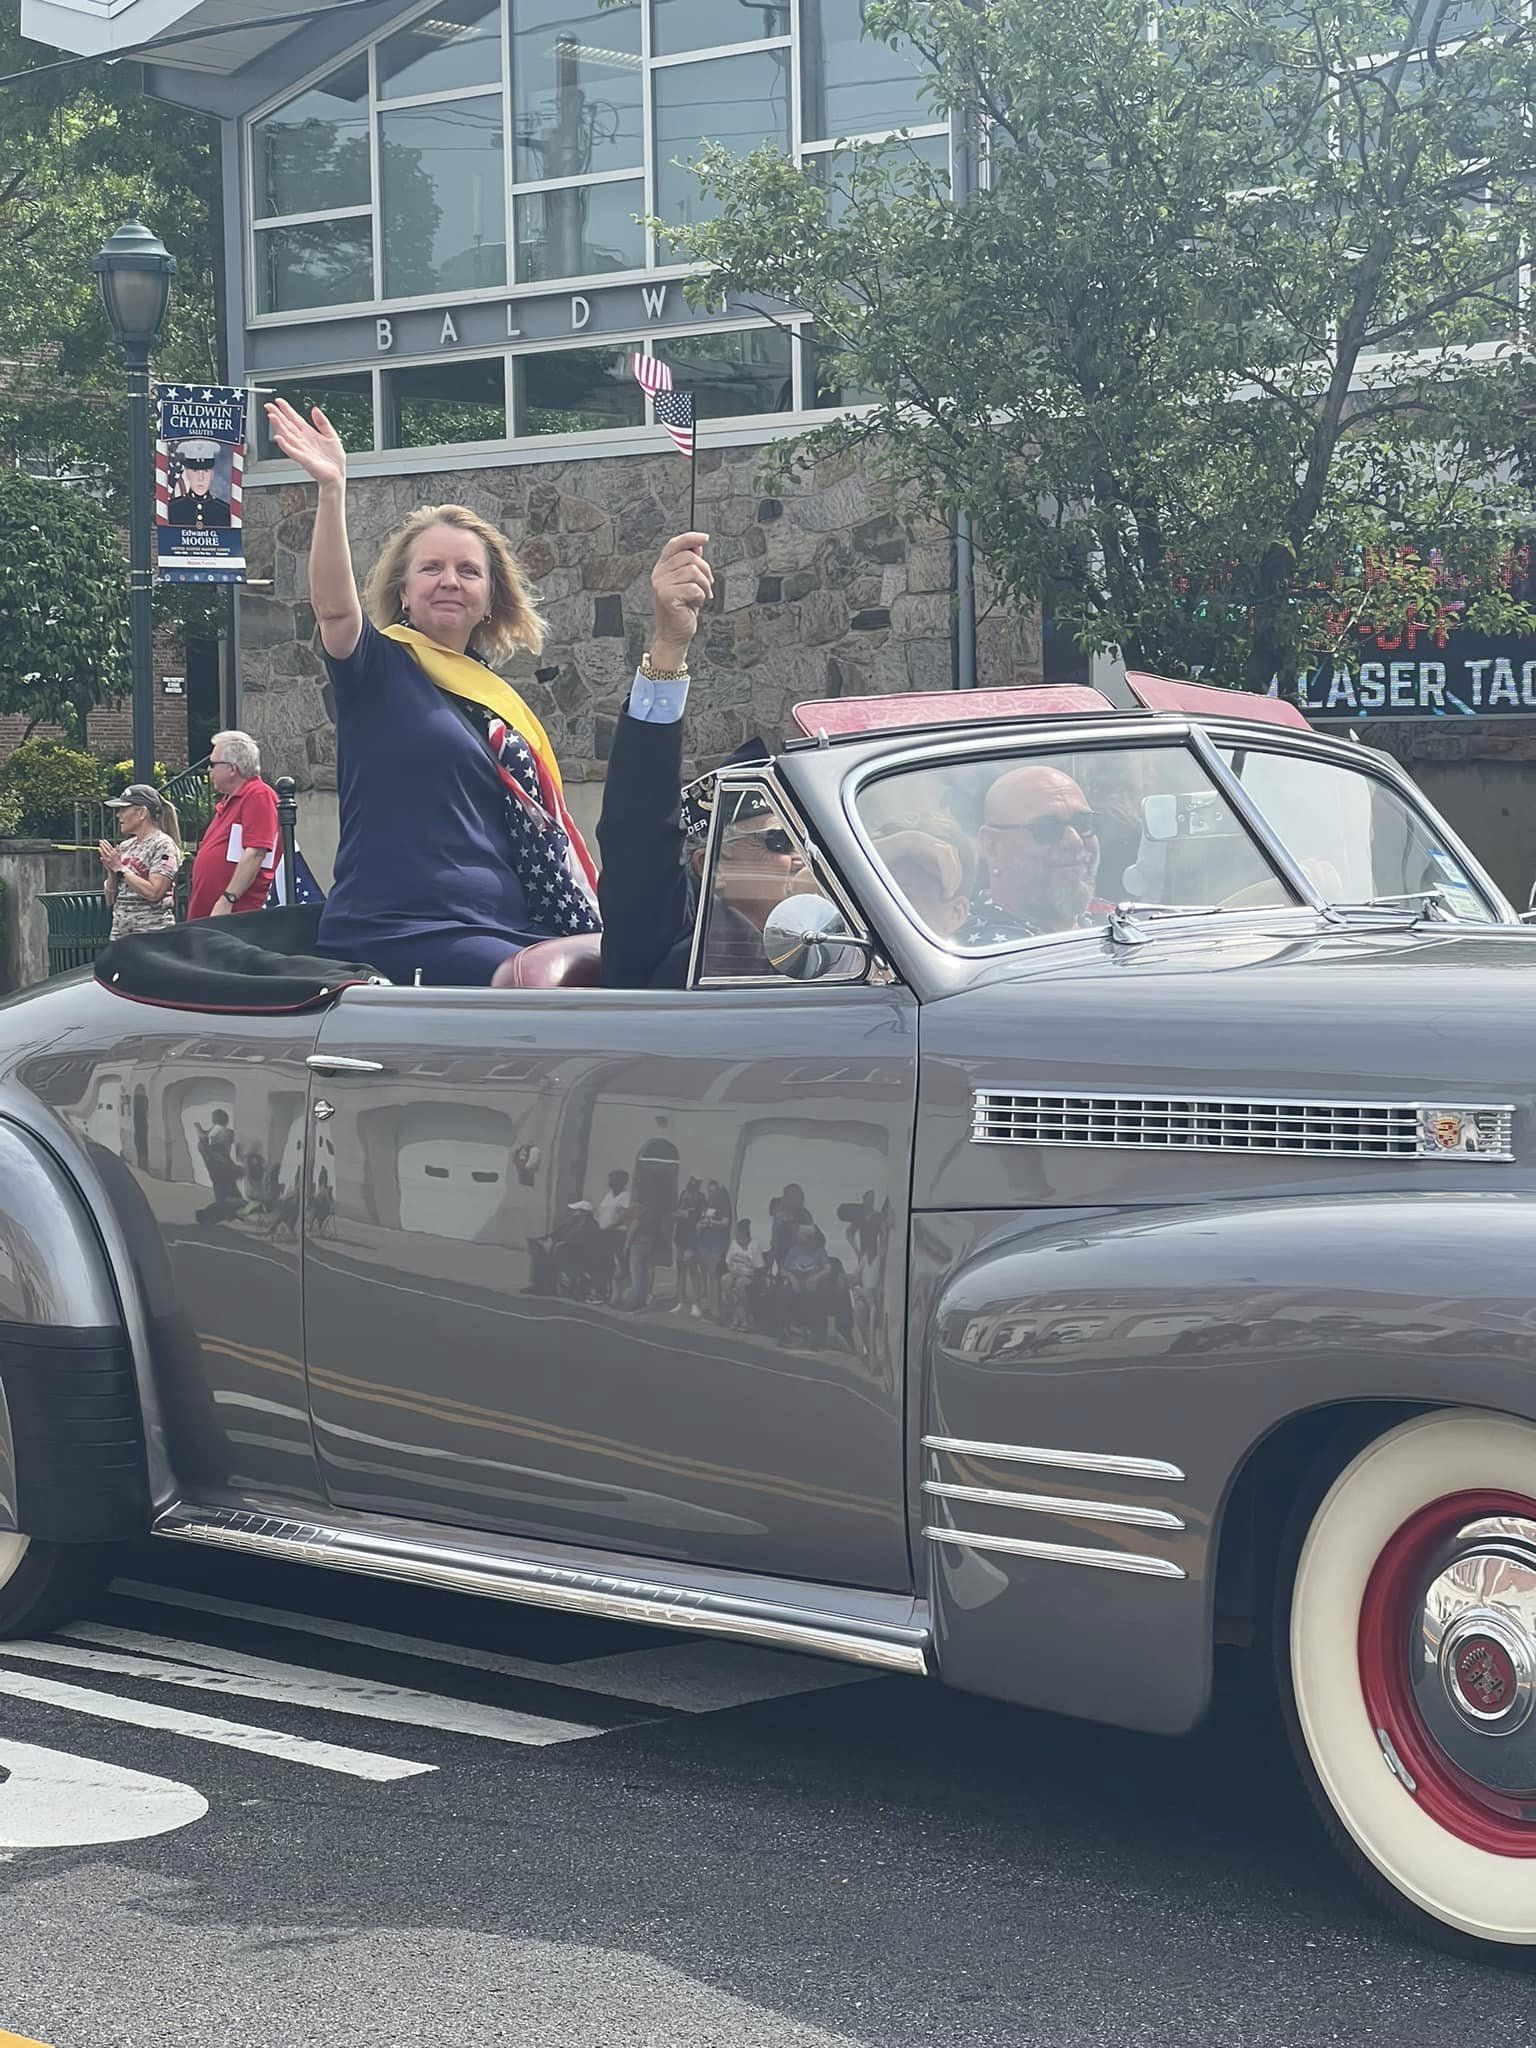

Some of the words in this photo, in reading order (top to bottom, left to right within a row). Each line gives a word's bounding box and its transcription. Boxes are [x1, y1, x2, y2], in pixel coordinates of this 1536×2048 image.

[376, 278, 795, 350] BALDWI
[172, 404, 232, 418] BALDWIN
[170, 416, 233, 430] CHAMBER
[181, 529, 209, 537] Edward
[181, 537, 220, 546] MOORE
[1298, 661, 1447, 708] LASER
